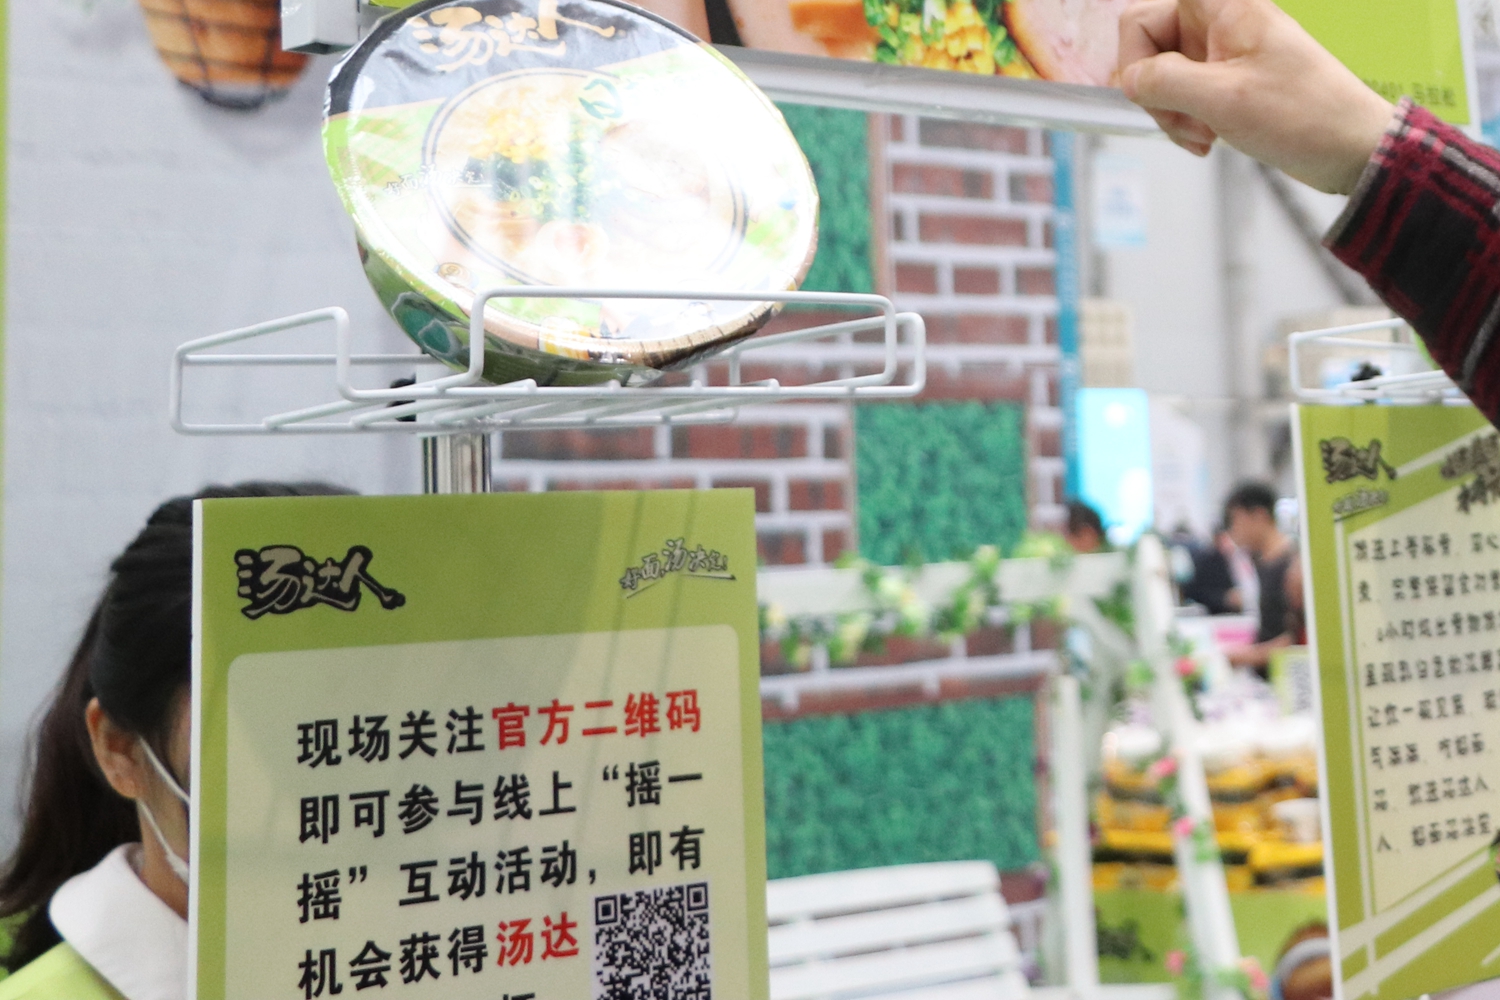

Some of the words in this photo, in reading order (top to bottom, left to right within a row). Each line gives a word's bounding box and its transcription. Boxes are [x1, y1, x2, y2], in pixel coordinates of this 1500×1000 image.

[234, 544, 406, 620] 汤达人
[297, 689, 702, 768] 现场关注官方二维码
[298, 912, 580, 999] 机会获得汤达
